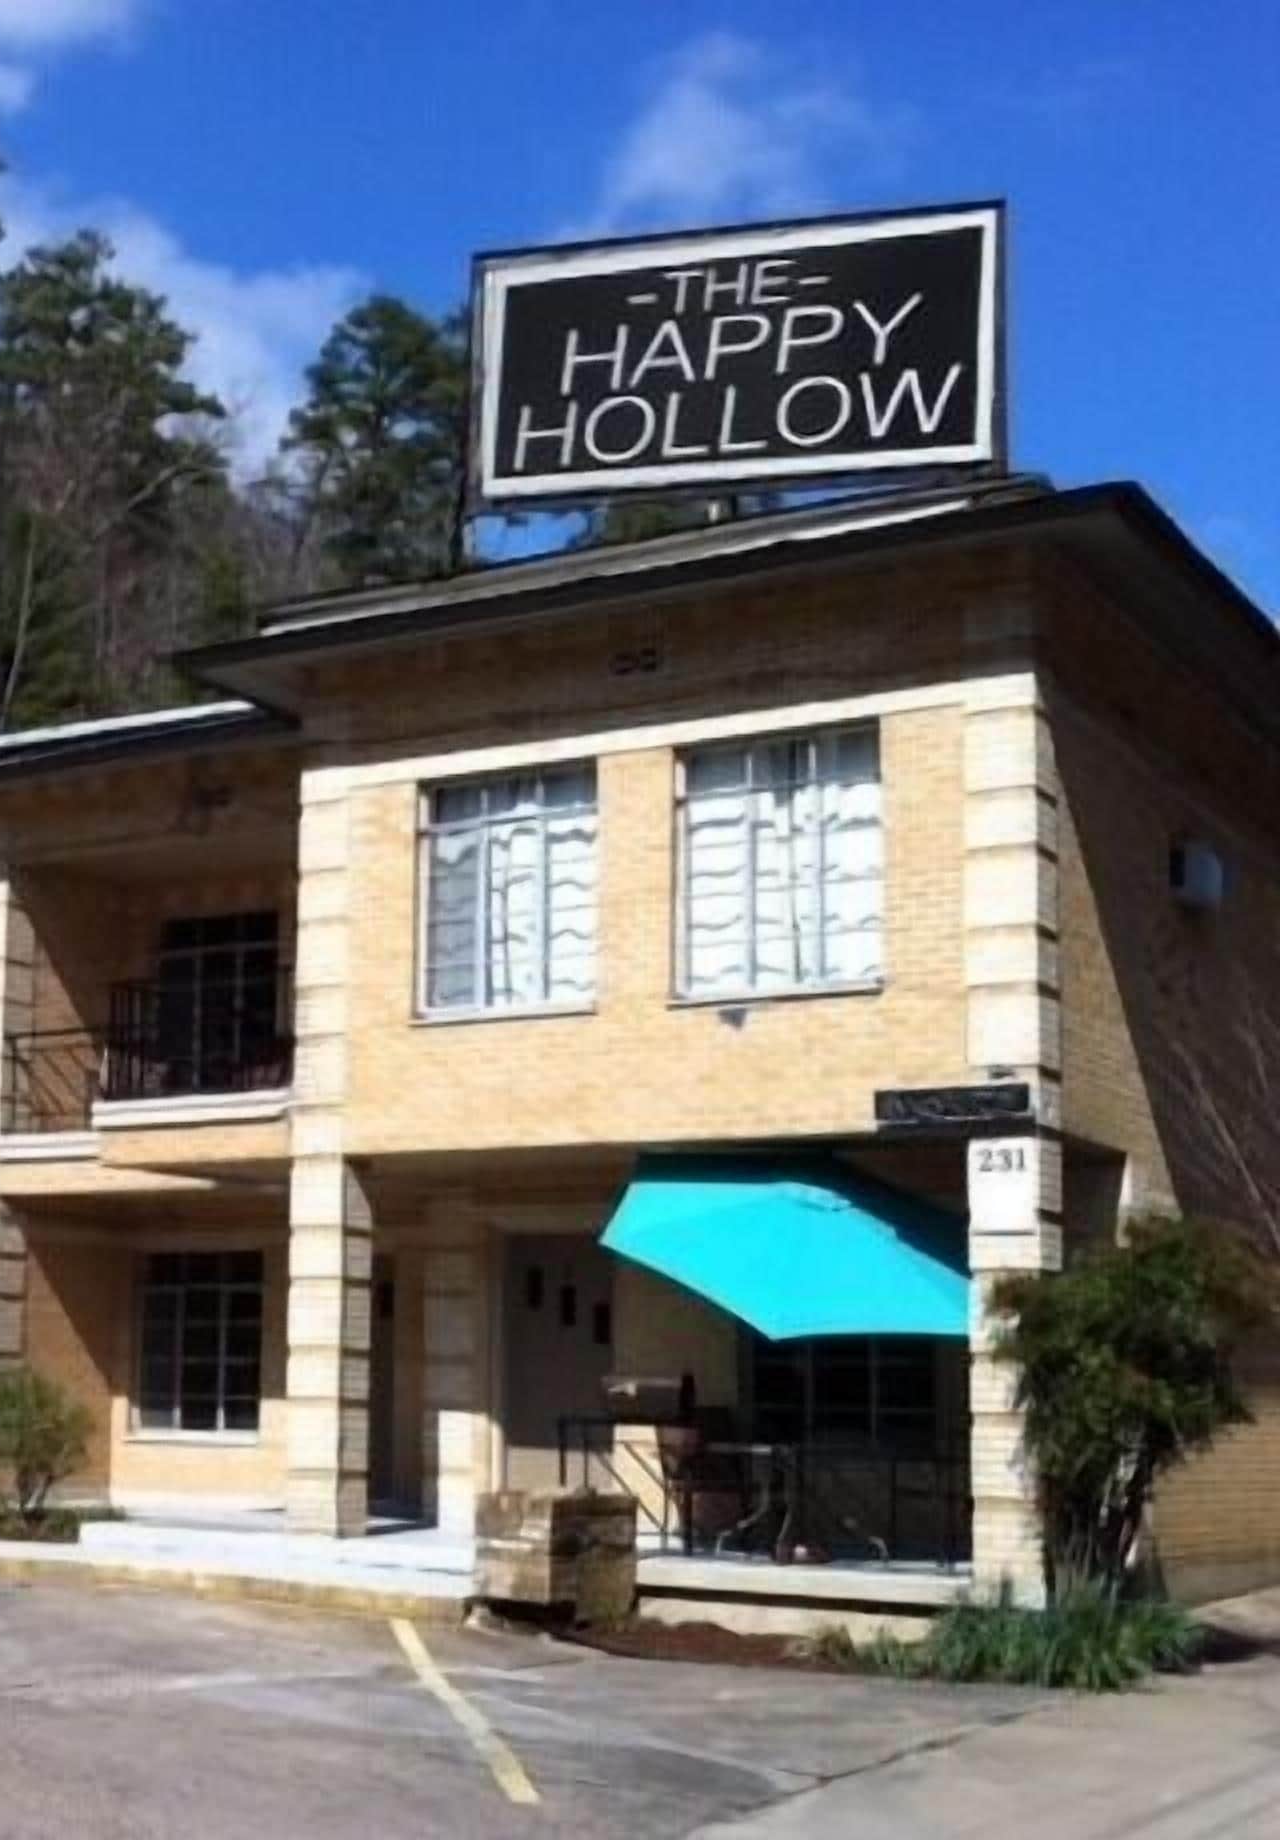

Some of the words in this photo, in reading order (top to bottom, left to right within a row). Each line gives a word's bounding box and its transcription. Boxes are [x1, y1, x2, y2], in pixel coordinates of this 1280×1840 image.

[561, 293, 922, 396] HAPPY
[514, 364, 962, 471] HOLLOW
[976, 1147, 1026, 1172] 231
